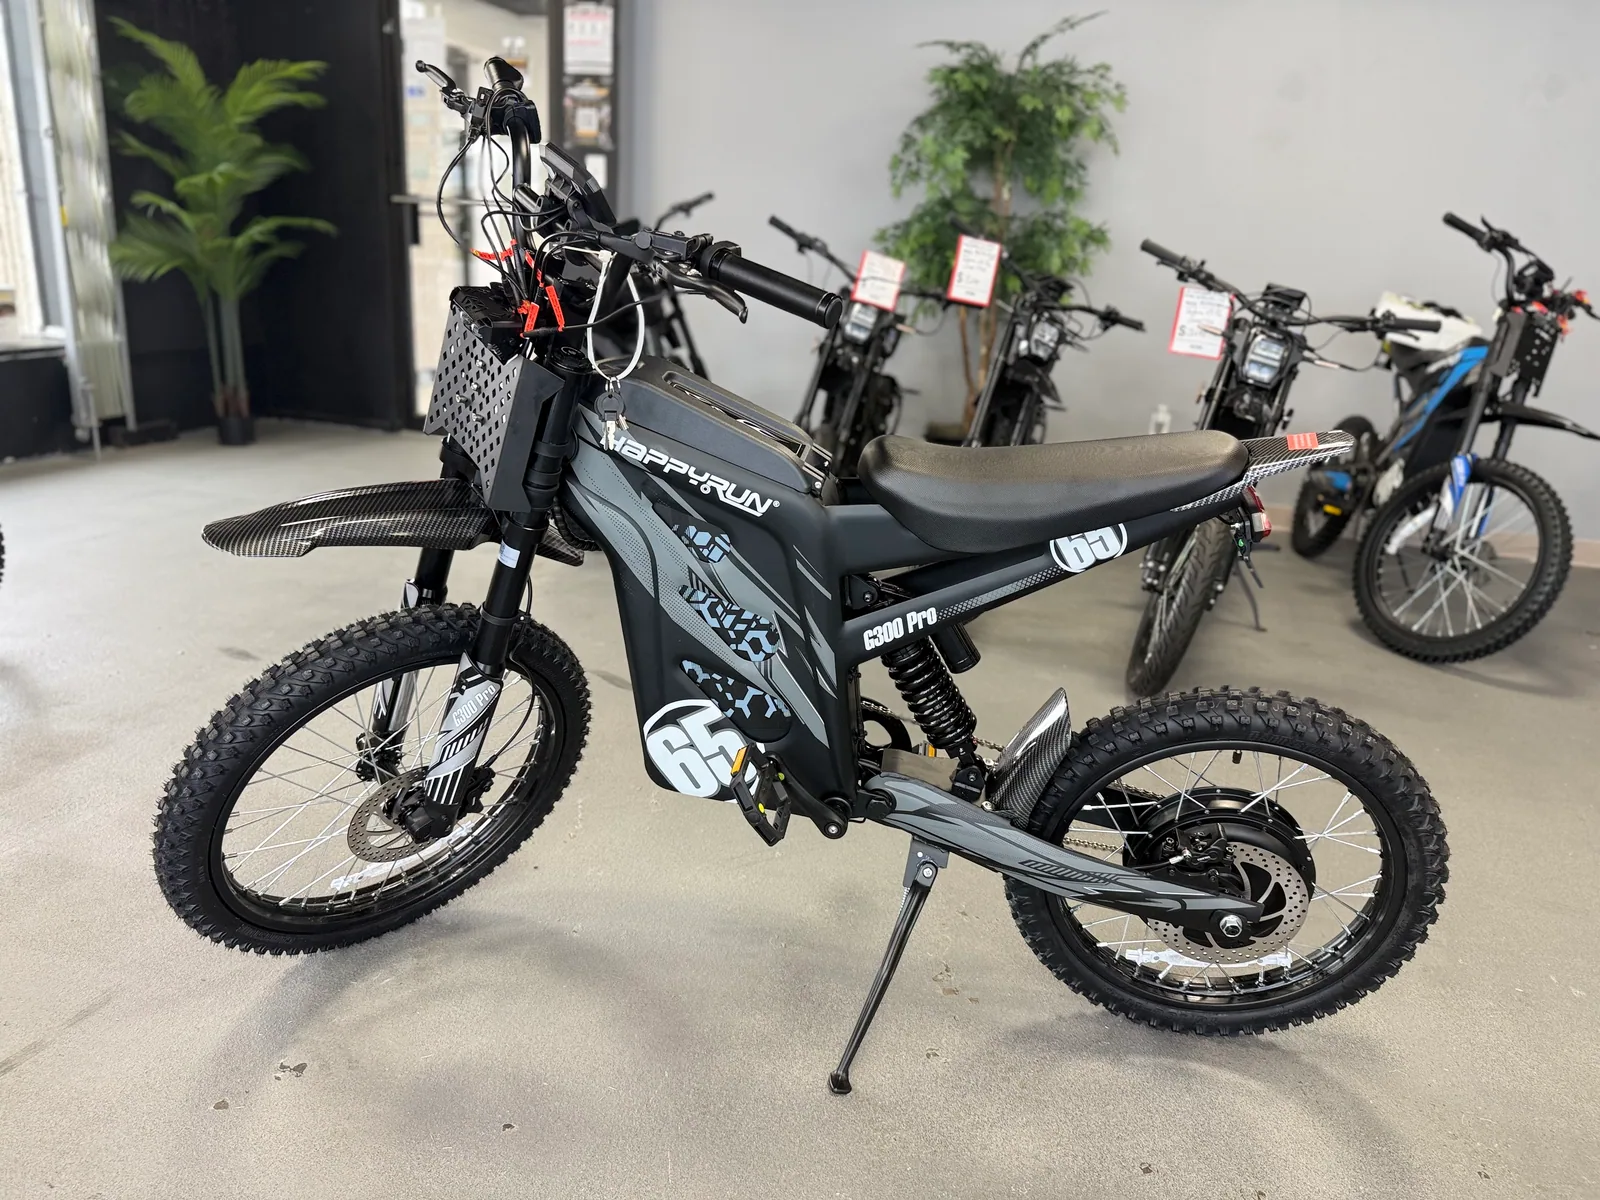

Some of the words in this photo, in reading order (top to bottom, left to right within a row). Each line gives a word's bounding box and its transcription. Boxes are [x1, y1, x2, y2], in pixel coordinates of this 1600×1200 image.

[863, 617, 904, 651] G300
[906, 607, 937, 634] Pro
[452, 700, 478, 727] G300
[475, 684, 496, 707] Pro
[646, 703, 757, 798] 65
